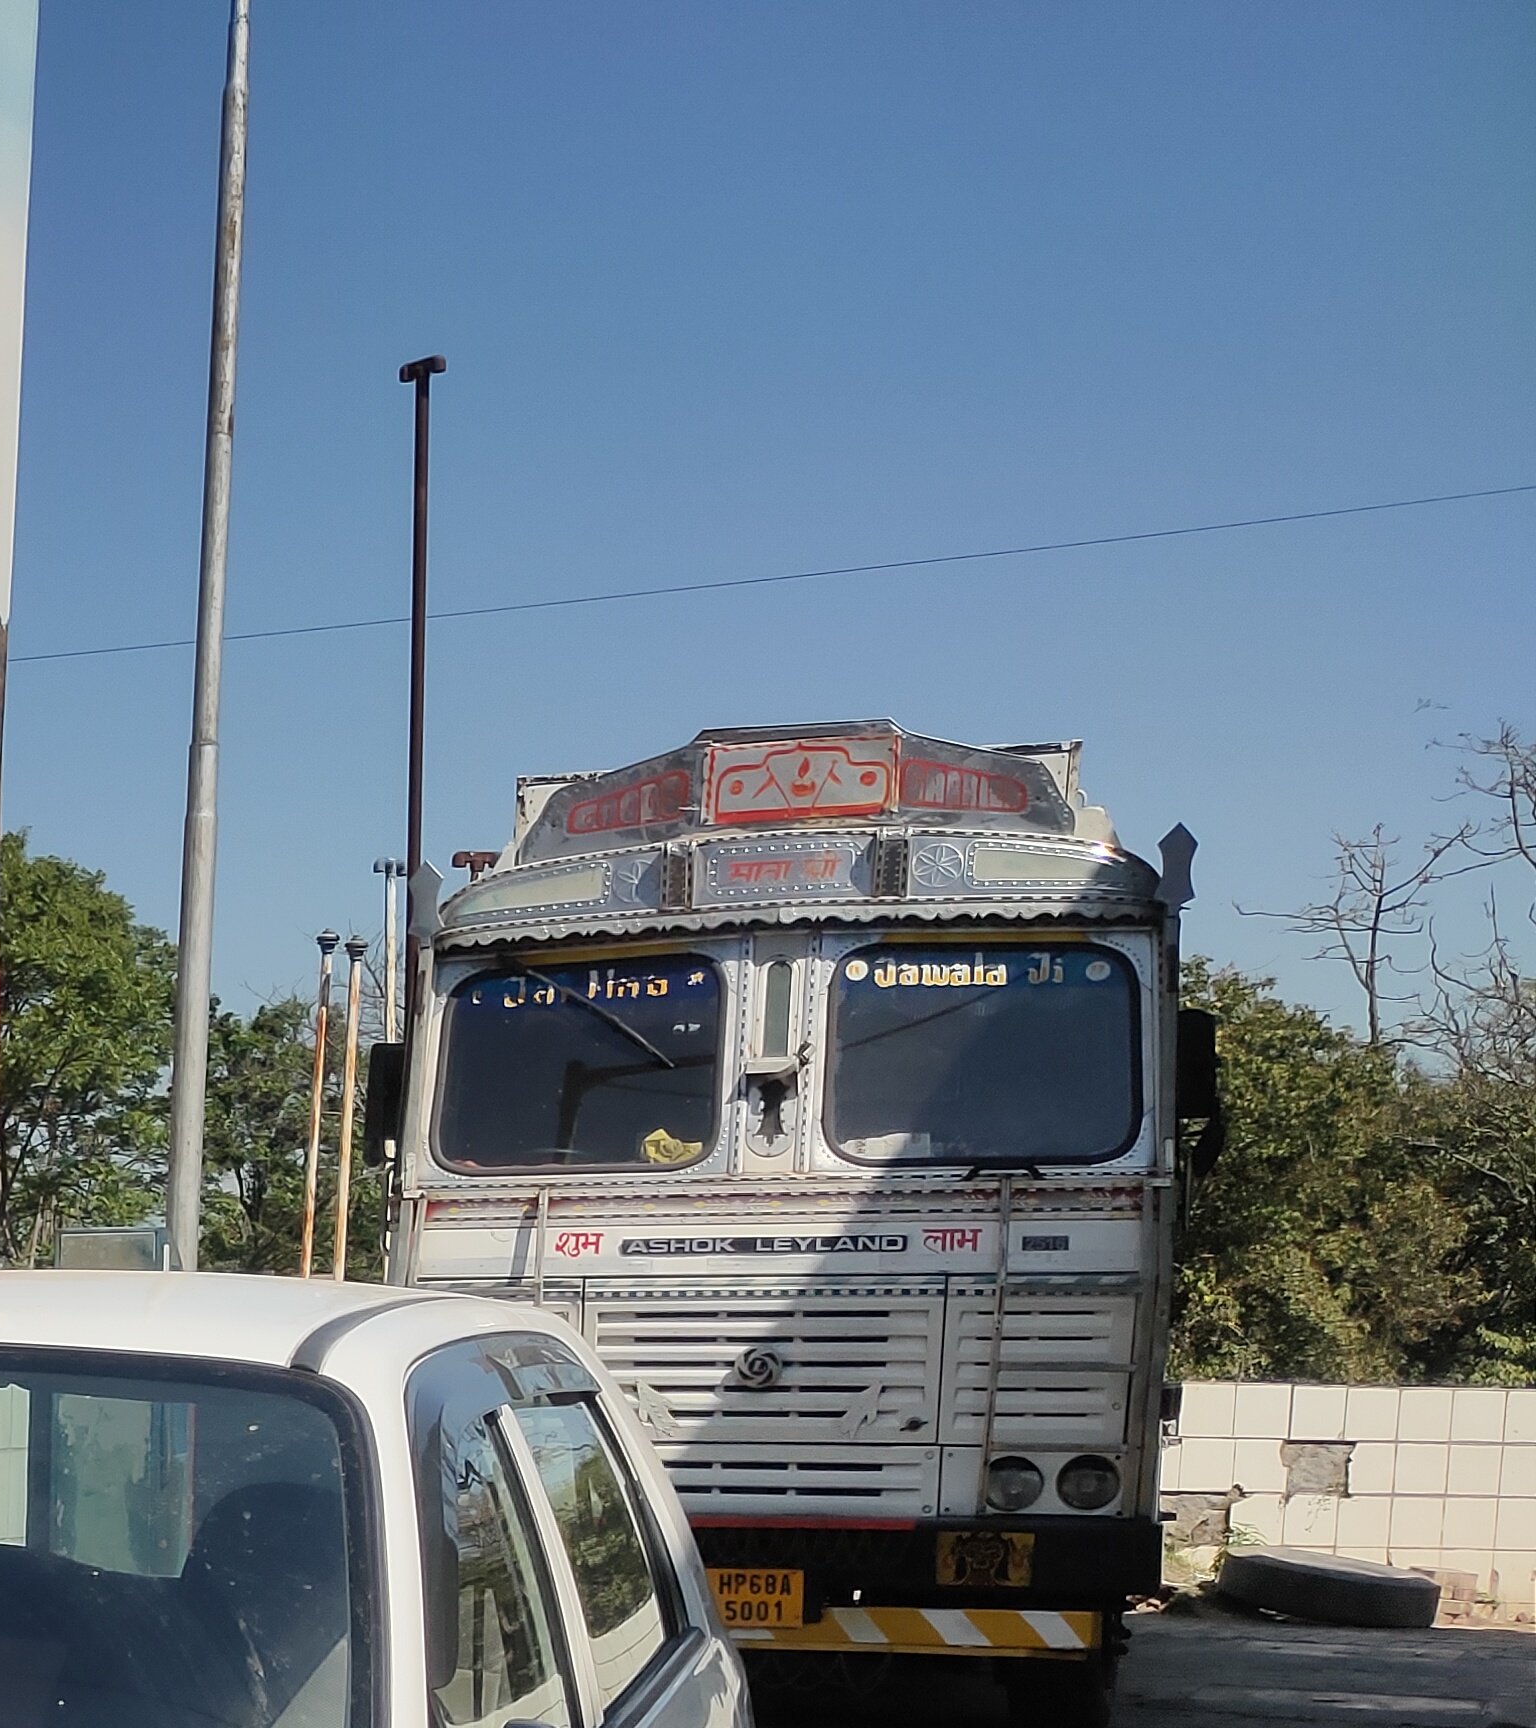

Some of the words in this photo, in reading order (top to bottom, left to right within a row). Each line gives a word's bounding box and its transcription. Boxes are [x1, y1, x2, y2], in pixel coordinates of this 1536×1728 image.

[873, 952, 1008, 988] Jawala
[1027, 952, 1064, 985] Ji
[555, 1232, 605, 1258] शुभ
[626, 1237, 736, 1254] ASHOK
[755, 1235, 905, 1253] LEYLAND
[922, 1228, 983, 1255] लाभ
[718, 1573, 792, 1596] HP68A
[724, 1600, 783, 1621] 5001
